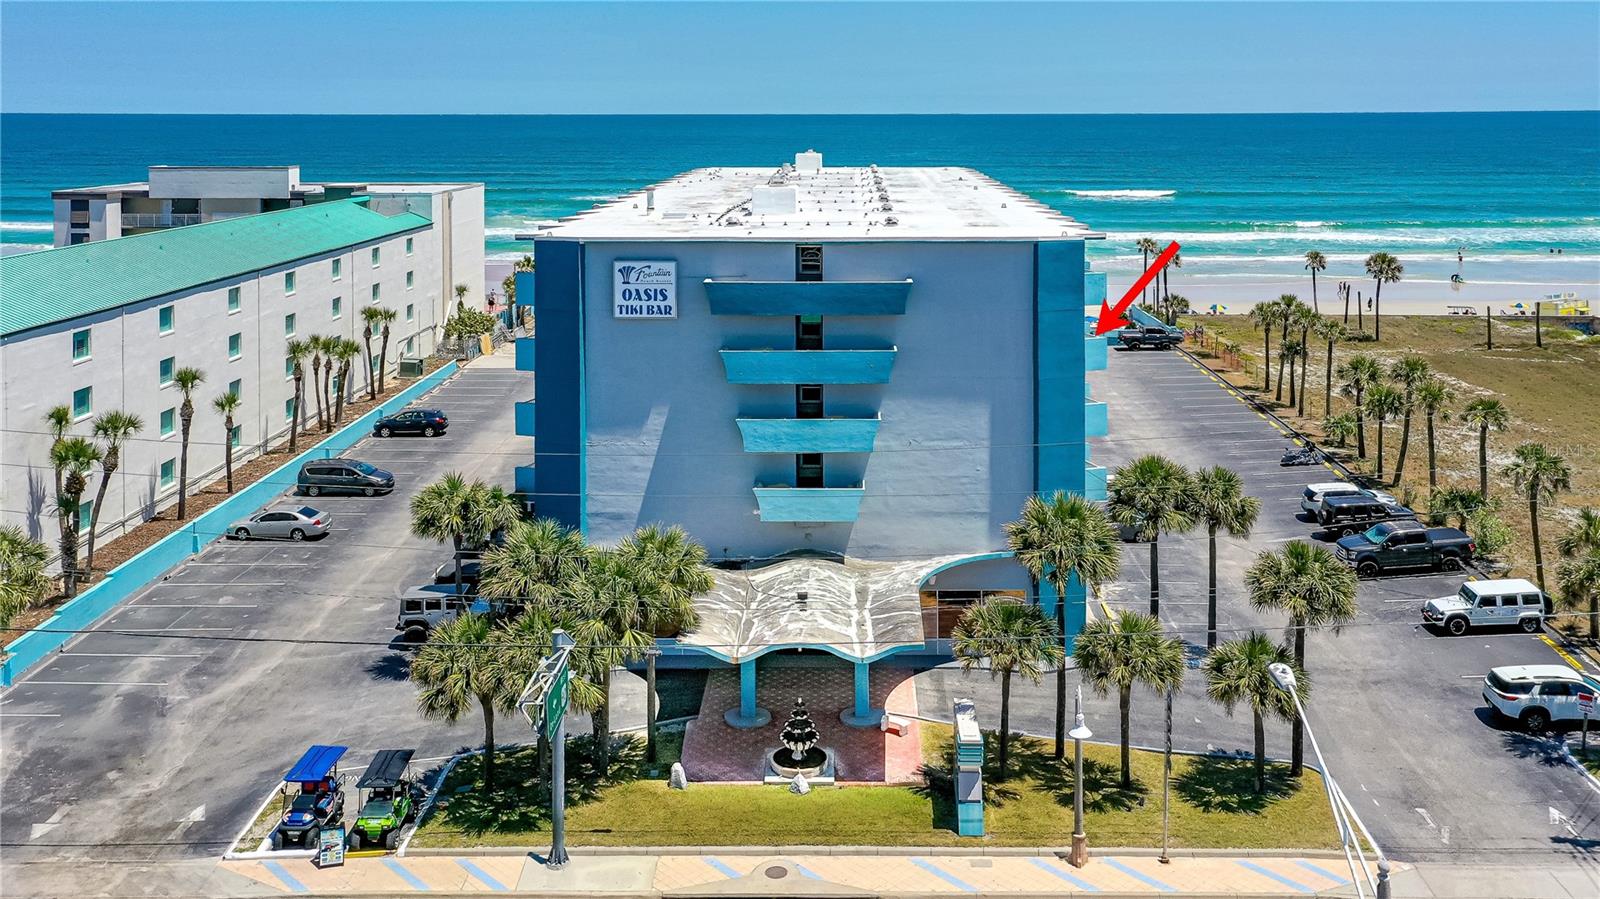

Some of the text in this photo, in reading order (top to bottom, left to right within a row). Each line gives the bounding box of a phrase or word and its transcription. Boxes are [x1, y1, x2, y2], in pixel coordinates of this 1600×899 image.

[633, 265, 672, 281] Fountain
[622, 288, 668, 301] OASIS
[617, 304, 672, 315] TIKI BAR
